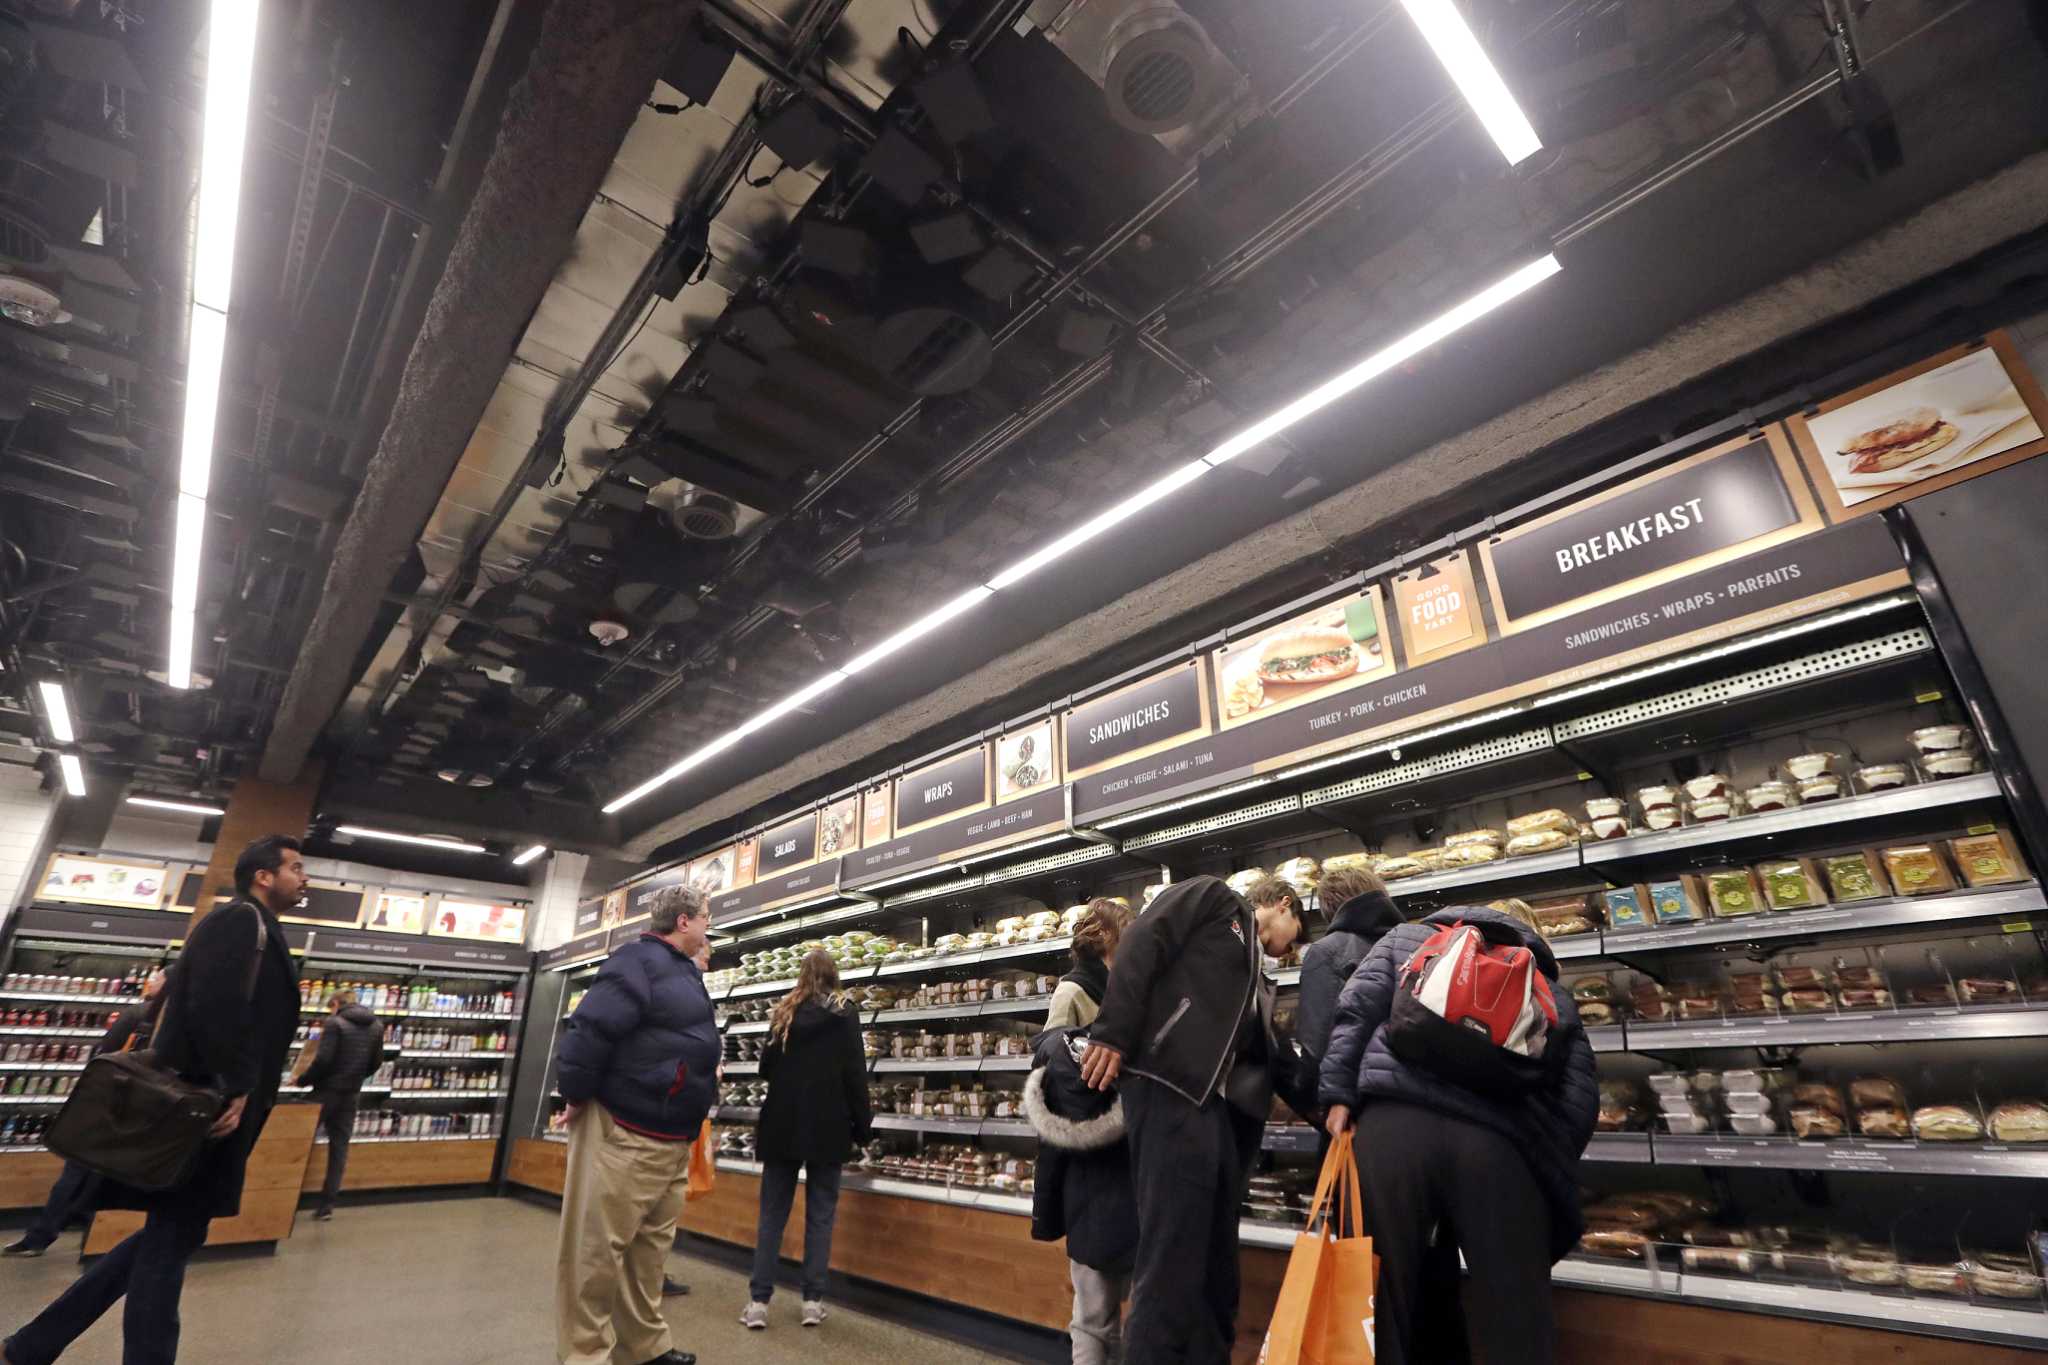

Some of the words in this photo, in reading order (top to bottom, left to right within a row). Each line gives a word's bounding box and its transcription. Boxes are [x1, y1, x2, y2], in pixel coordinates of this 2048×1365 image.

[1555, 498, 1705, 574] BREAKFAST
[1411, 591, 1461, 624] FOOD
[1416, 583, 1450, 602] GOOD
[1565, 612, 1650, 649] SANDWICHES
[1662, 592, 1715, 619] WRAPS
[1728, 563, 1802, 598] PARFAITS
[1424, 615, 1454, 631] FAST
[1089, 700, 1170, 744] SANDWICHES
[1309, 711, 1342, 731] TURKEY
[1350, 701, 1376, 717] PORK
[1383, 683, 1427, 708] CHICKEN
[1102, 778, 1129, 794] CHICKEN
[1134, 769, 1157, 785] VEGGIE
[1163, 760, 1189, 776] SALAMI
[1195, 752, 1214, 766] TUNA
[924, 781, 953, 804] WRAPS
[774, 839, 796, 858] SALADS
